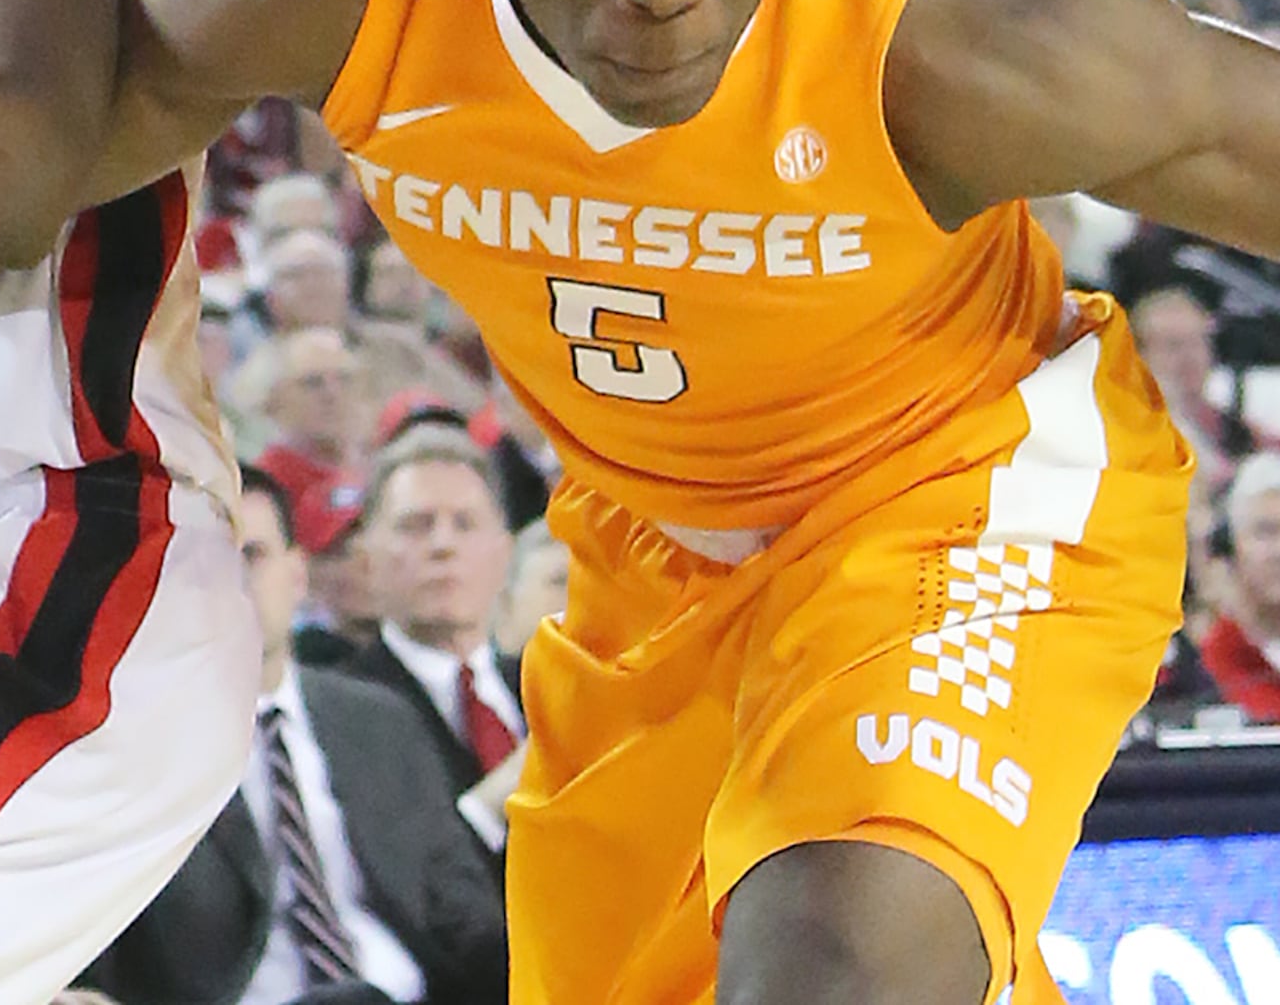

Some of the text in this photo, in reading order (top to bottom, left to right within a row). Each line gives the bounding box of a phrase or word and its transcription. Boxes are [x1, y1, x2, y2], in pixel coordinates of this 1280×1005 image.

[345, 153, 871, 277] TENNESSEE
[778, 132, 823, 180] SEC
[546, 276, 689, 404] 5
[856, 713, 1032, 828] VOLS
